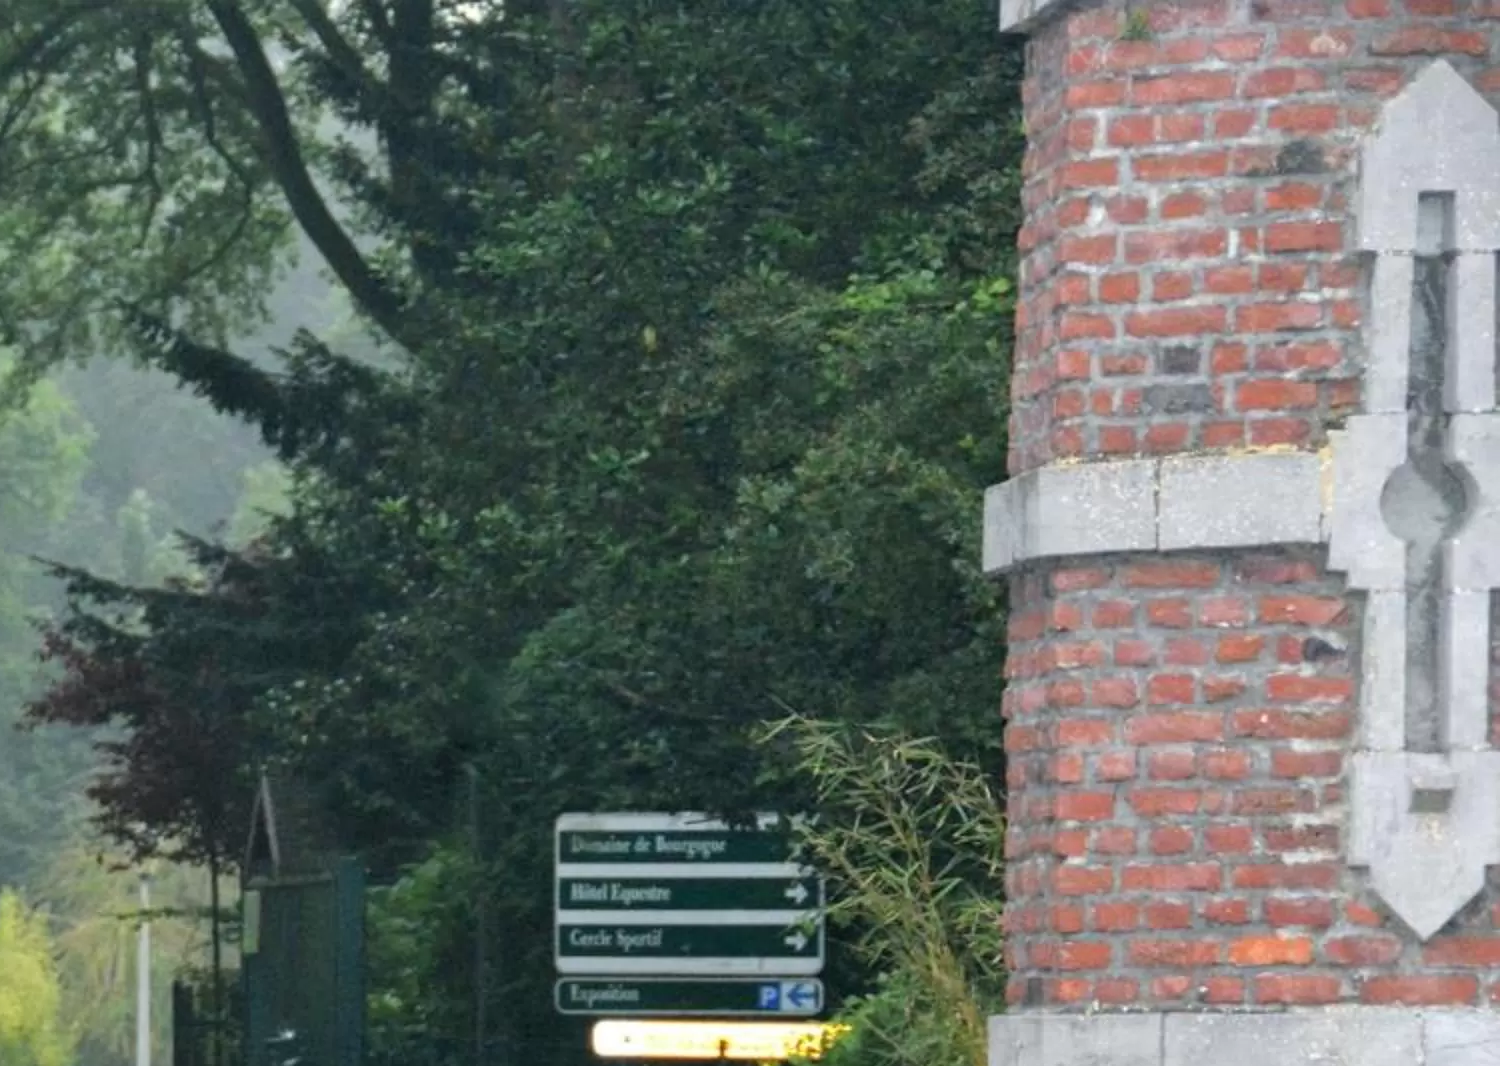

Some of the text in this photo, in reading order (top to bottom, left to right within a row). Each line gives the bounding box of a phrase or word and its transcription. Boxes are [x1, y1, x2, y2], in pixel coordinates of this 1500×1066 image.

[571, 835, 631, 853] Domaine
[634, 836, 651, 852] de
[610, 883, 671, 905] Equestre
[570, 928, 663, 953] Cercle Sportif
[762, 987, 778, 1005] P
